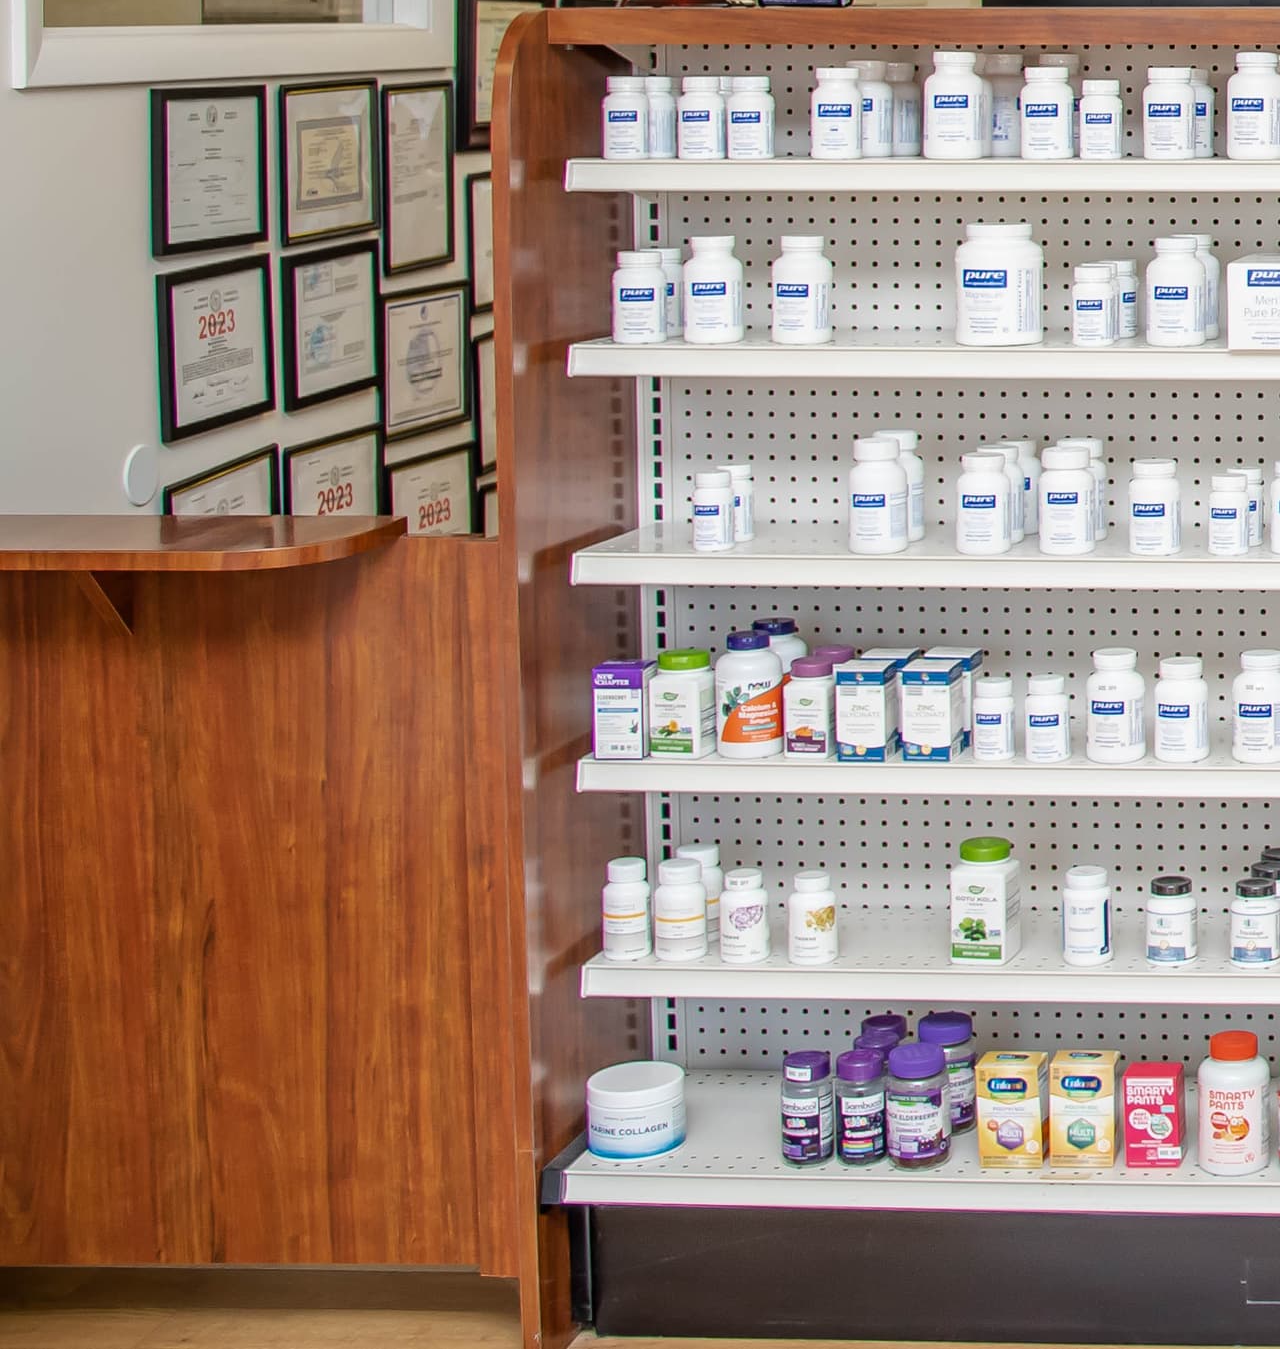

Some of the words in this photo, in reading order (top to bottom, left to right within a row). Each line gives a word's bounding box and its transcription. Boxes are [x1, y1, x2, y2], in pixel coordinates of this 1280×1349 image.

[936, 96, 967, 104] pure
[820, 105, 850, 113] pure
[1028, 105, 1056, 113] pure
[1151, 105, 1179, 113] pure
[965, 271, 1005, 282] pure
[694, 284, 724, 292] pure
[1157, 287, 1186, 295] pure
[1244, 306, 1269, 318] Pure
[198, 311, 236, 339] 2023
[317, 484, 354, 516] 2023
[964, 496, 994, 504] pure
[418, 498, 452, 530] 2023
[1135, 505, 1163, 513] pure
[595, 678, 630, 686] CHAPTER
[740, 703, 769, 713] Calcium
[1094, 702, 1123, 710] pure
[1241, 705, 1270, 713] pure
[738, 709, 778, 720] Magnesium
[1127, 1086, 1174, 1096] SMARTY
[1209, 1090, 1255, 1101] SMARTY
[1127, 1095, 1164, 1105] PANTS
[1209, 1099, 1244, 1110] PANTS
[618, 1122, 669, 1136] COLLAGEN
